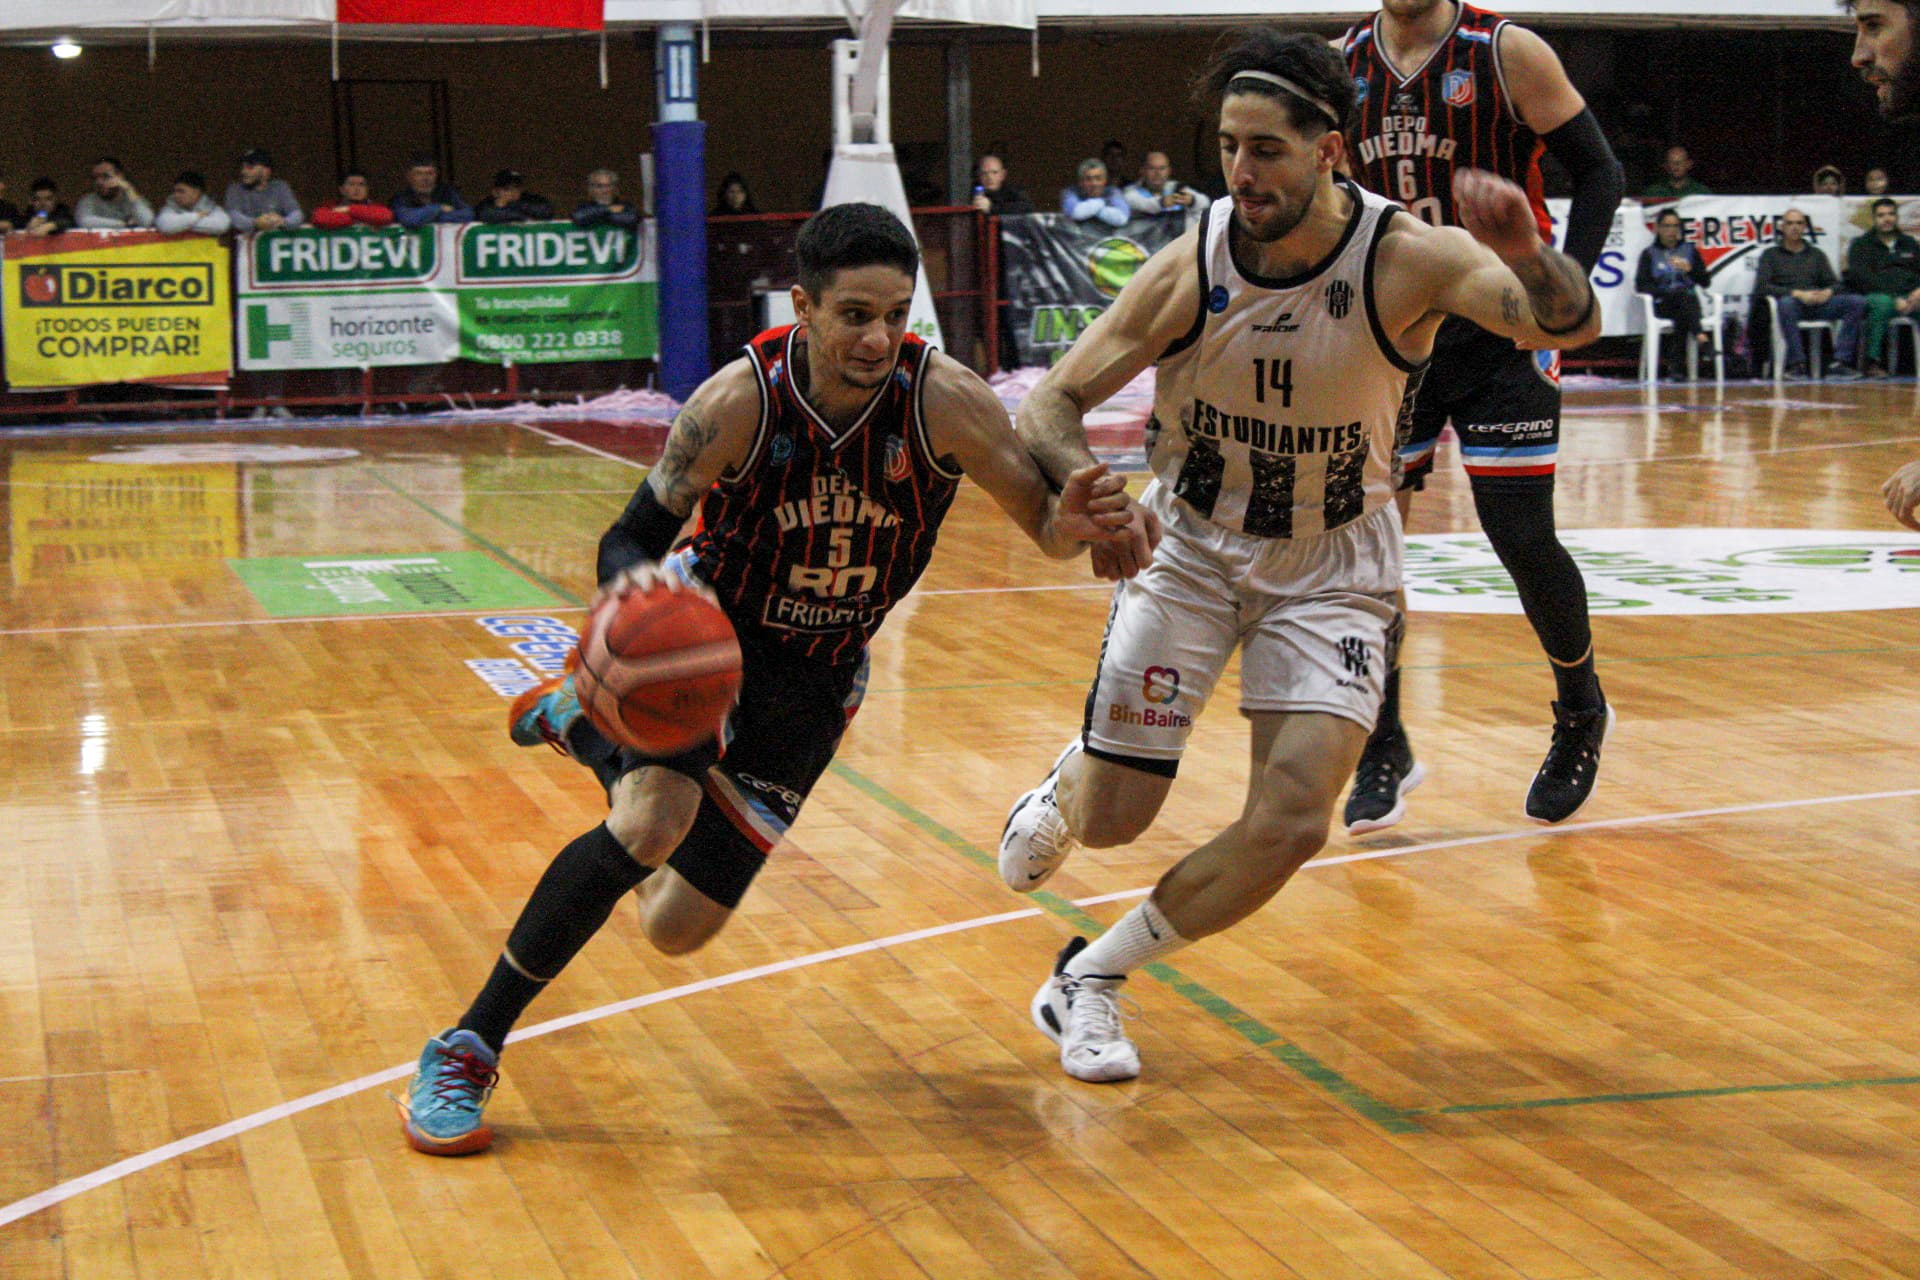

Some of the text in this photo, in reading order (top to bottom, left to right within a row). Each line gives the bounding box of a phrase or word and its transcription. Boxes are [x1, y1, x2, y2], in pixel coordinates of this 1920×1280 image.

[1382, 116, 1426, 132] DEPO
[1397, 159, 1417, 200] 6
[270, 236, 420, 272] FRIDEVI
[476, 231, 625, 268] FRIDEVI
[68, 270, 203, 300] Diarco
[118, 317, 200, 332] PUEDEN
[330, 316, 435, 337] horizonte
[38, 335, 200, 358] COMPRAR!
[333, 339, 417, 361] seguros
[531, 332, 567, 348] 222
[573, 329, 623, 346] 0338
[1253, 358, 1293, 408] 14
[1193, 398, 1362, 455] ESTUDIANTES
[1468, 419, 1553, 433] CEFERINO
[814, 475, 864, 497] DE
[828, 528, 853, 567] 5
[1109, 704, 1191, 727] BinBaires
